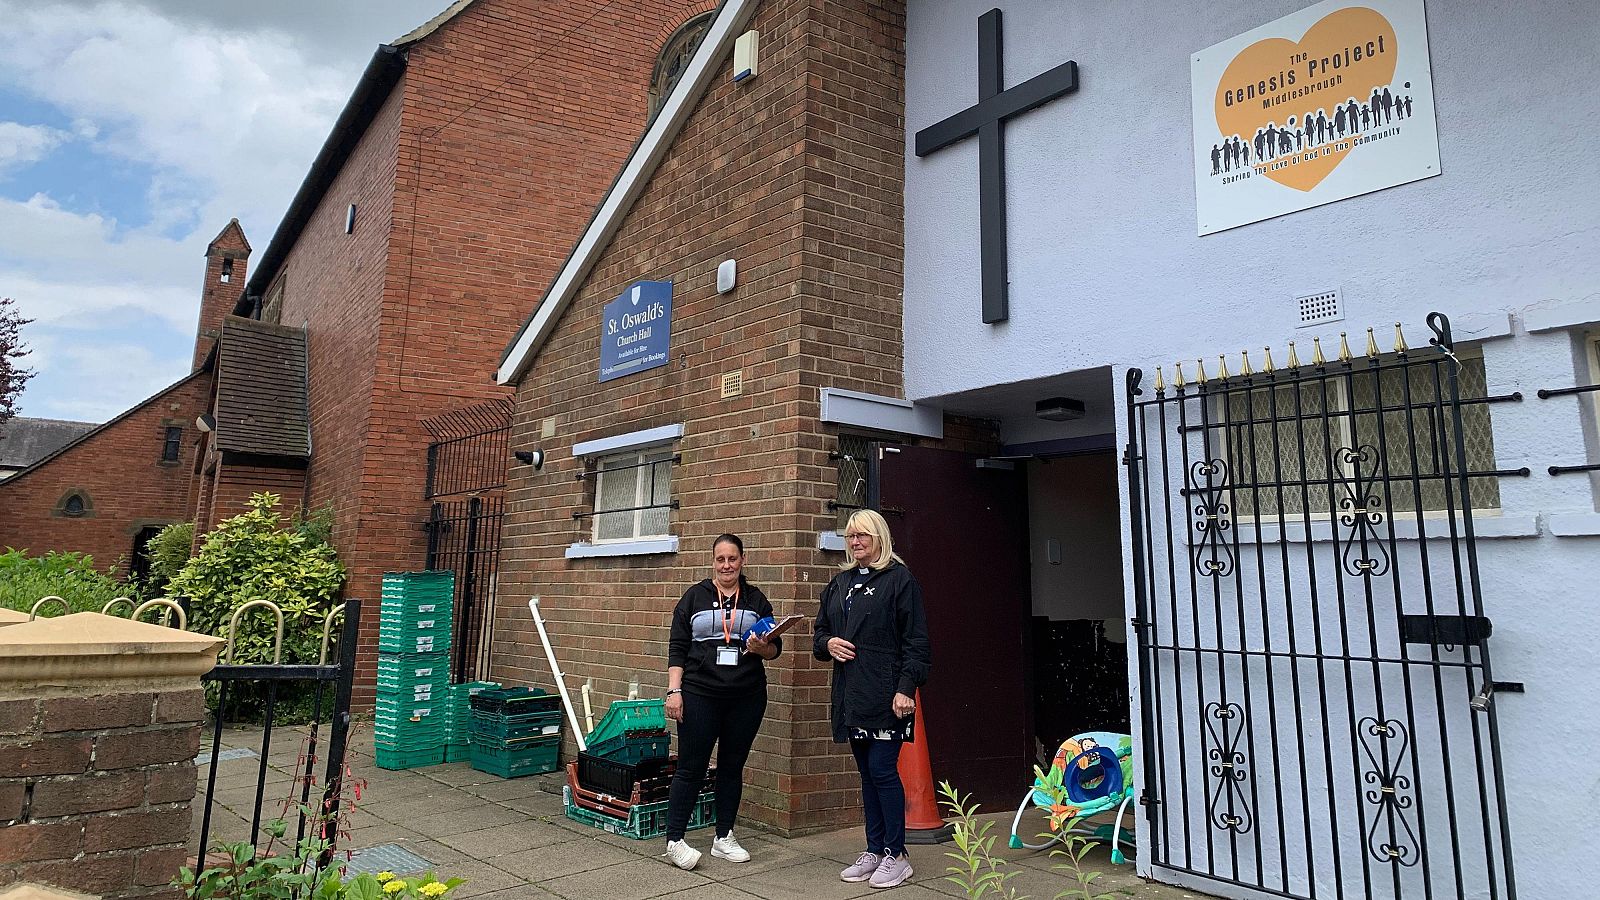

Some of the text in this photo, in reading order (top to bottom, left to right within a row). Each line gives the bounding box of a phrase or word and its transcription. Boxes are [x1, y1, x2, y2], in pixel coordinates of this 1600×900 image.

[1225, 36, 1384, 107] Genesis Project
[1290, 52, 1308, 65] The
[1263, 75, 1342, 109] Middlesbrough
[1222, 172, 1251, 185] Sharing
[1255, 167, 1267, 176] The
[1271, 160, 1288, 171] Love
[1292, 156, 1300, 165] Of
[1304, 151, 1318, 161] God
[1335, 142, 1349, 152] The
[1353, 126, 1401, 146] Community
[608, 302, 664, 335] St. Oswald's
[617, 326, 652, 347] Church Hall
[617, 348, 634, 359] Available
[648, 352, 666, 361] Bookings
